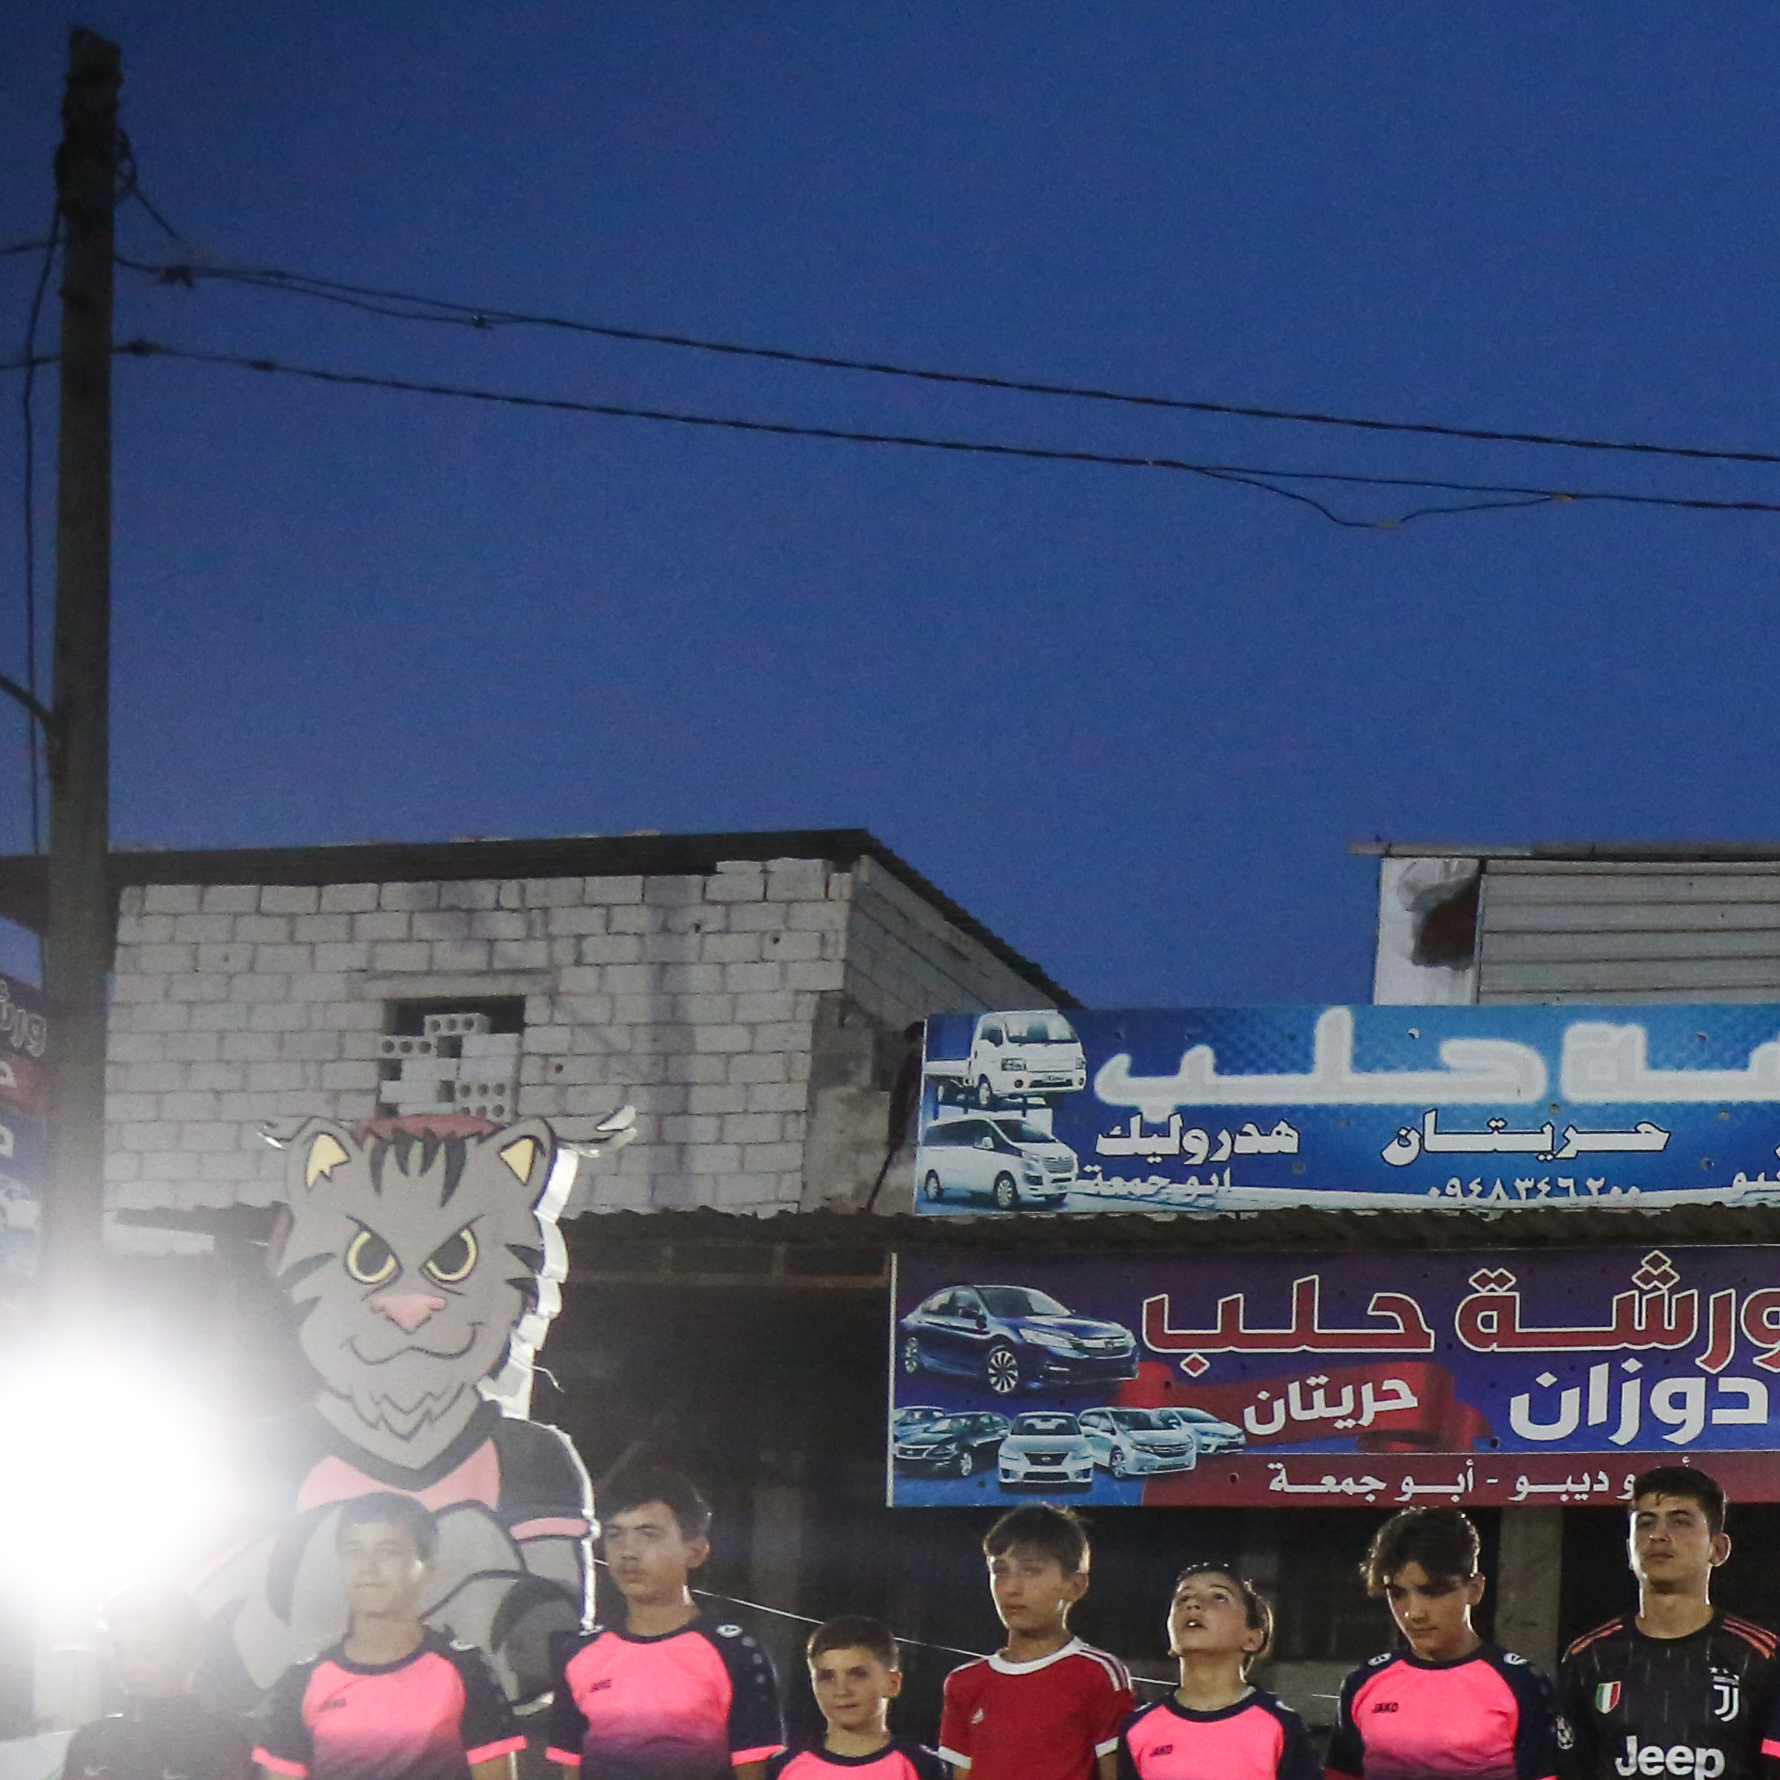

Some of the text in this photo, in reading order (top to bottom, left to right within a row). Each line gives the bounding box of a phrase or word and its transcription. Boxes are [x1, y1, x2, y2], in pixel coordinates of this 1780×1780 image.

[1093, 1005, 1549, 1121] حلب
[1095, 1112, 1300, 1166] هدروليك
[1380, 1107, 1672, 1167] حريتان
[1141, 1274, 1435, 1378] حلب
[1242, 1374, 1419, 1436] حريتان
[1508, 1357, 1771, 1446] دوزان
[1266, 1460, 1388, 1504] جمعة
[1393, 1458, 1475, 1504] أبو
[1506, 1469, 1611, 1503] ديبو
[1373, 1702, 1398, 1713] JAKO
